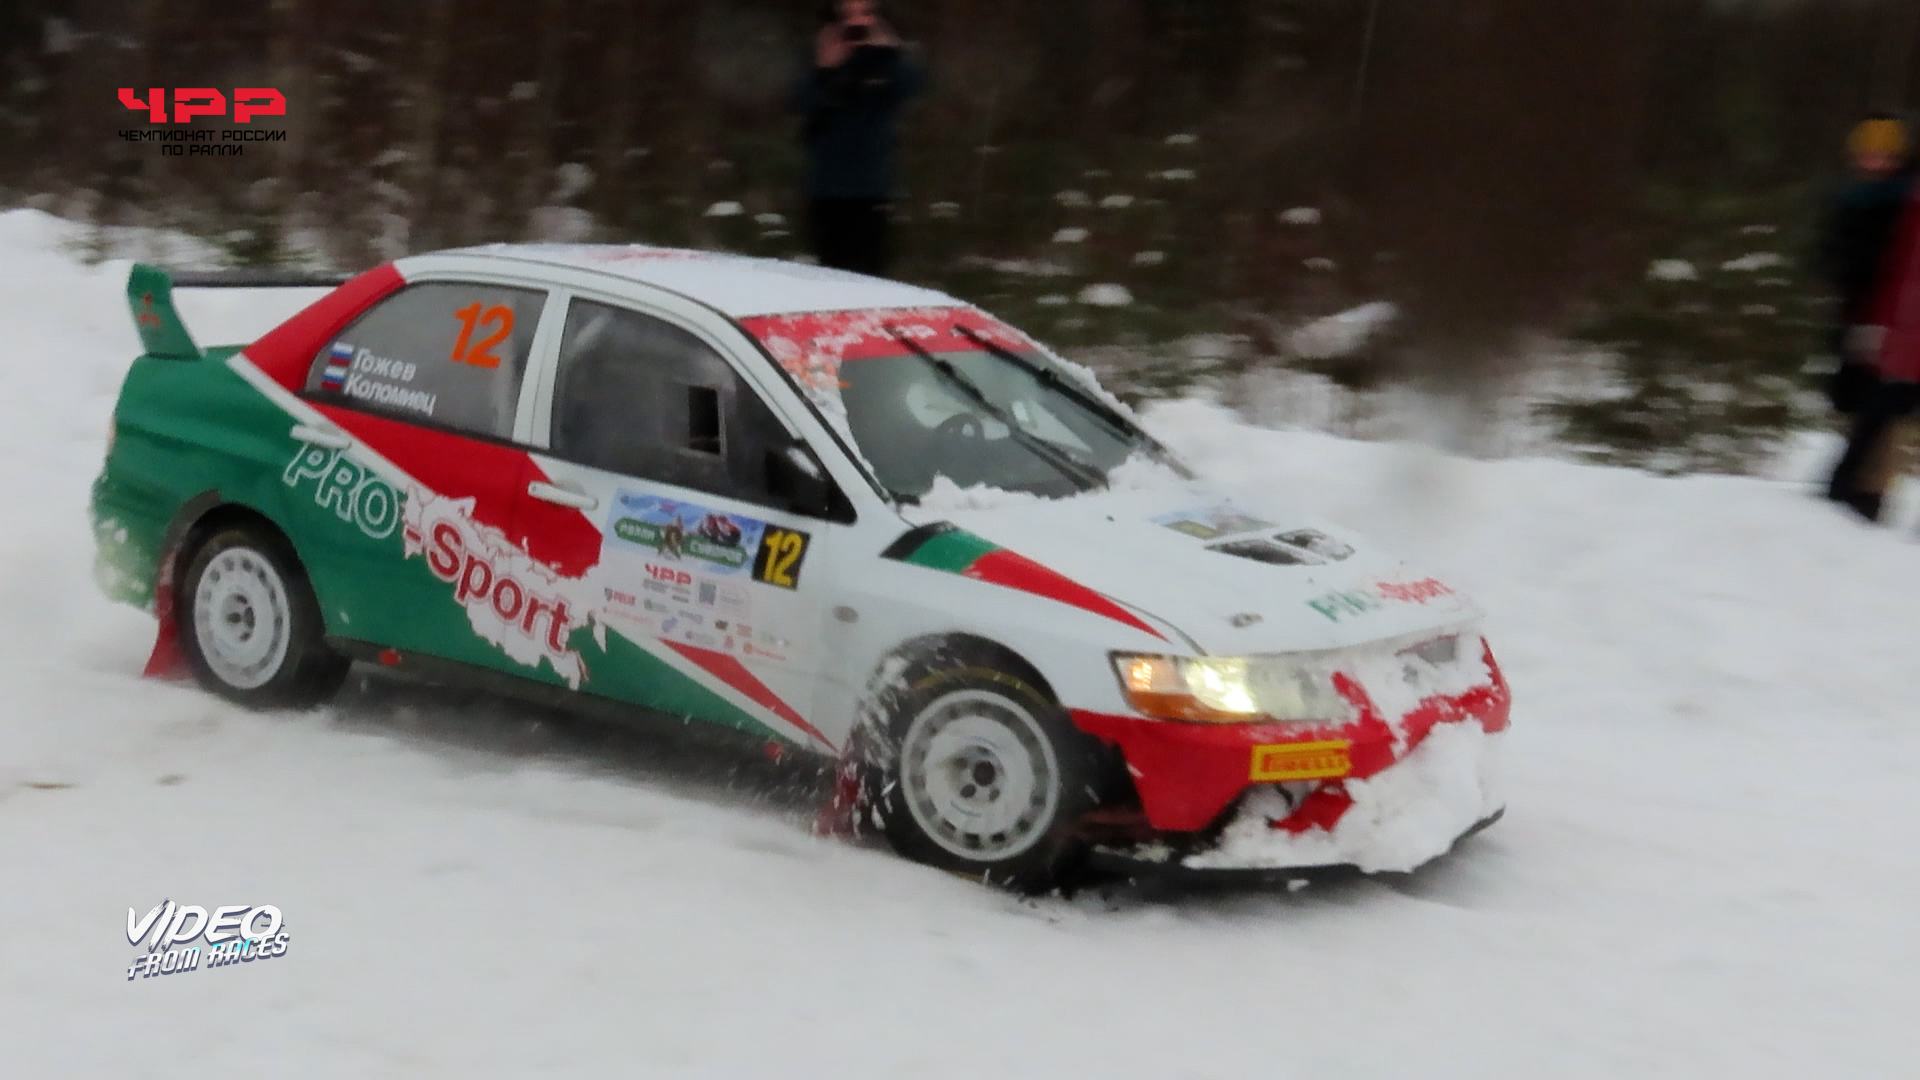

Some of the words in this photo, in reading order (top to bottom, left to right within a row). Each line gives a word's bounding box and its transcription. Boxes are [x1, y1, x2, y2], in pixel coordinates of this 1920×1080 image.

[450, 302, 515, 368] 12
[353, 348, 417, 382] Гожев
[344, 373, 437, 417] Коломиец
[763, 529, 803, 587] 12
